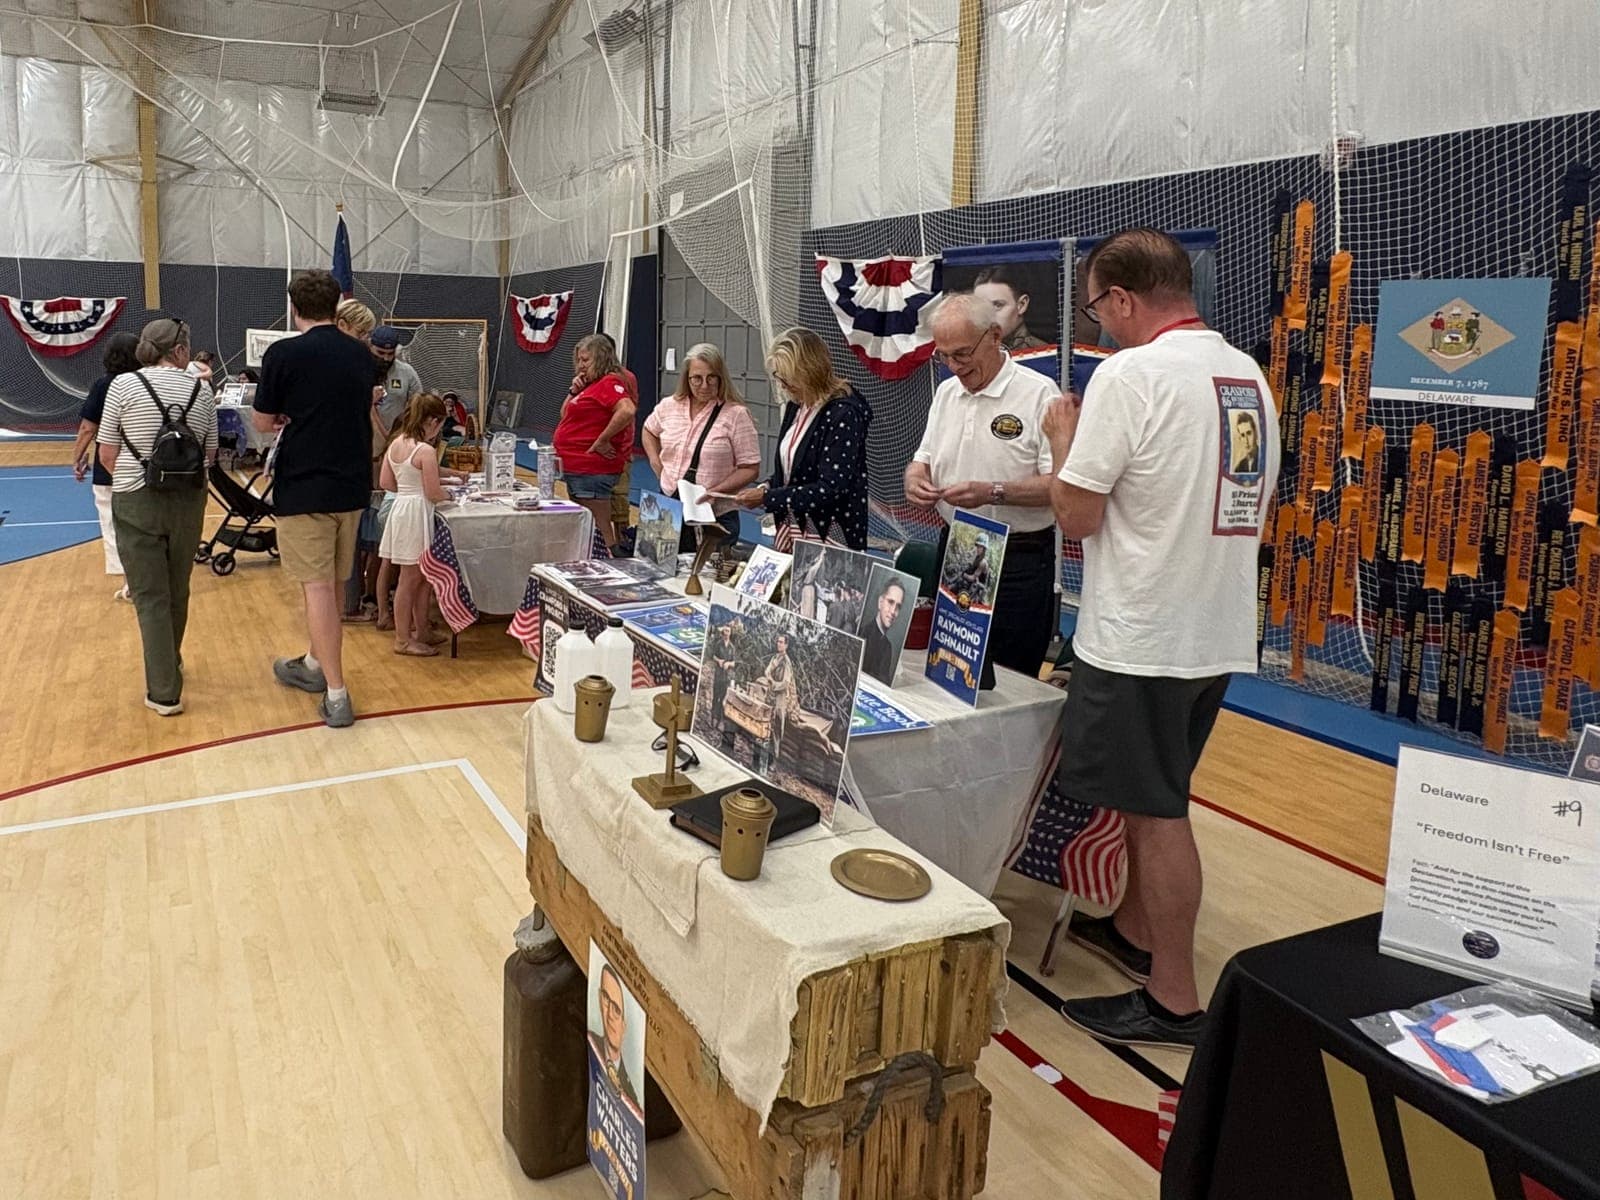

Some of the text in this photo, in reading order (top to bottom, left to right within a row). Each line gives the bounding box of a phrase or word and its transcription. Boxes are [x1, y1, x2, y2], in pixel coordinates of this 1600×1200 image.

[1303, 224, 1311, 248] JOHN
[1300, 260, 1309, 304] PRESCOTT
[1319, 288, 1328, 312] KARL
[1337, 284, 1346, 322] THOMAS
[1314, 331, 1324, 364] HEZEL
[1354, 351, 1368, 432] ANTHONY C. VAIL
[1410, 377, 1454, 386] DECEMBER
[1466, 380, 1488, 390] 1787
[1418, 392, 1477, 404] DELAWARE
[1552, 370, 1562, 393] World
[1558, 348, 1577, 443] ARTHUR S. KING
[1551, 395, 1559, 410] War
[1306, 437, 1317, 474] ROBERT
[1392, 477, 1402, 502] DANIEL
[1474, 458, 1486, 490] JAMES
[1501, 464, 1513, 494] DAVID
[1413, 450, 1429, 535] CECIL SPITTLER
[1442, 476, 1454, 510] HAROLD
[1487, 479, 1499, 538] Korean Conflict
[1283, 530, 1292, 554] PAUL
[1495, 507, 1508, 556] HAMILTON
[1518, 490, 1536, 580] JOHN S. BROMAGE
[1548, 548, 1562, 580] CHARLES
[1260, 566, 1270, 599] DONALD
[1319, 545, 1331, 622] THOMAS CULLEN
[934, 630, 980, 662] ASHNAULT
[937, 616, 980, 646] RAYMOND
[1450, 611, 1460, 652] GILBERT
[1477, 620, 1490, 654] CHARLES
[1561, 619, 1576, 665] CLIFFORD
[1502, 638, 1514, 674] RICHARD
[1556, 678, 1570, 712] DRAKE
[1420, 783, 1489, 806] Delaware
[1552, 800, 1582, 826] #9
[1416, 822, 1570, 865] "Freedom Isn't Free"
[596, 1080, 638, 1160] CHARLES
[596, 1098, 638, 1182] WATTERS
